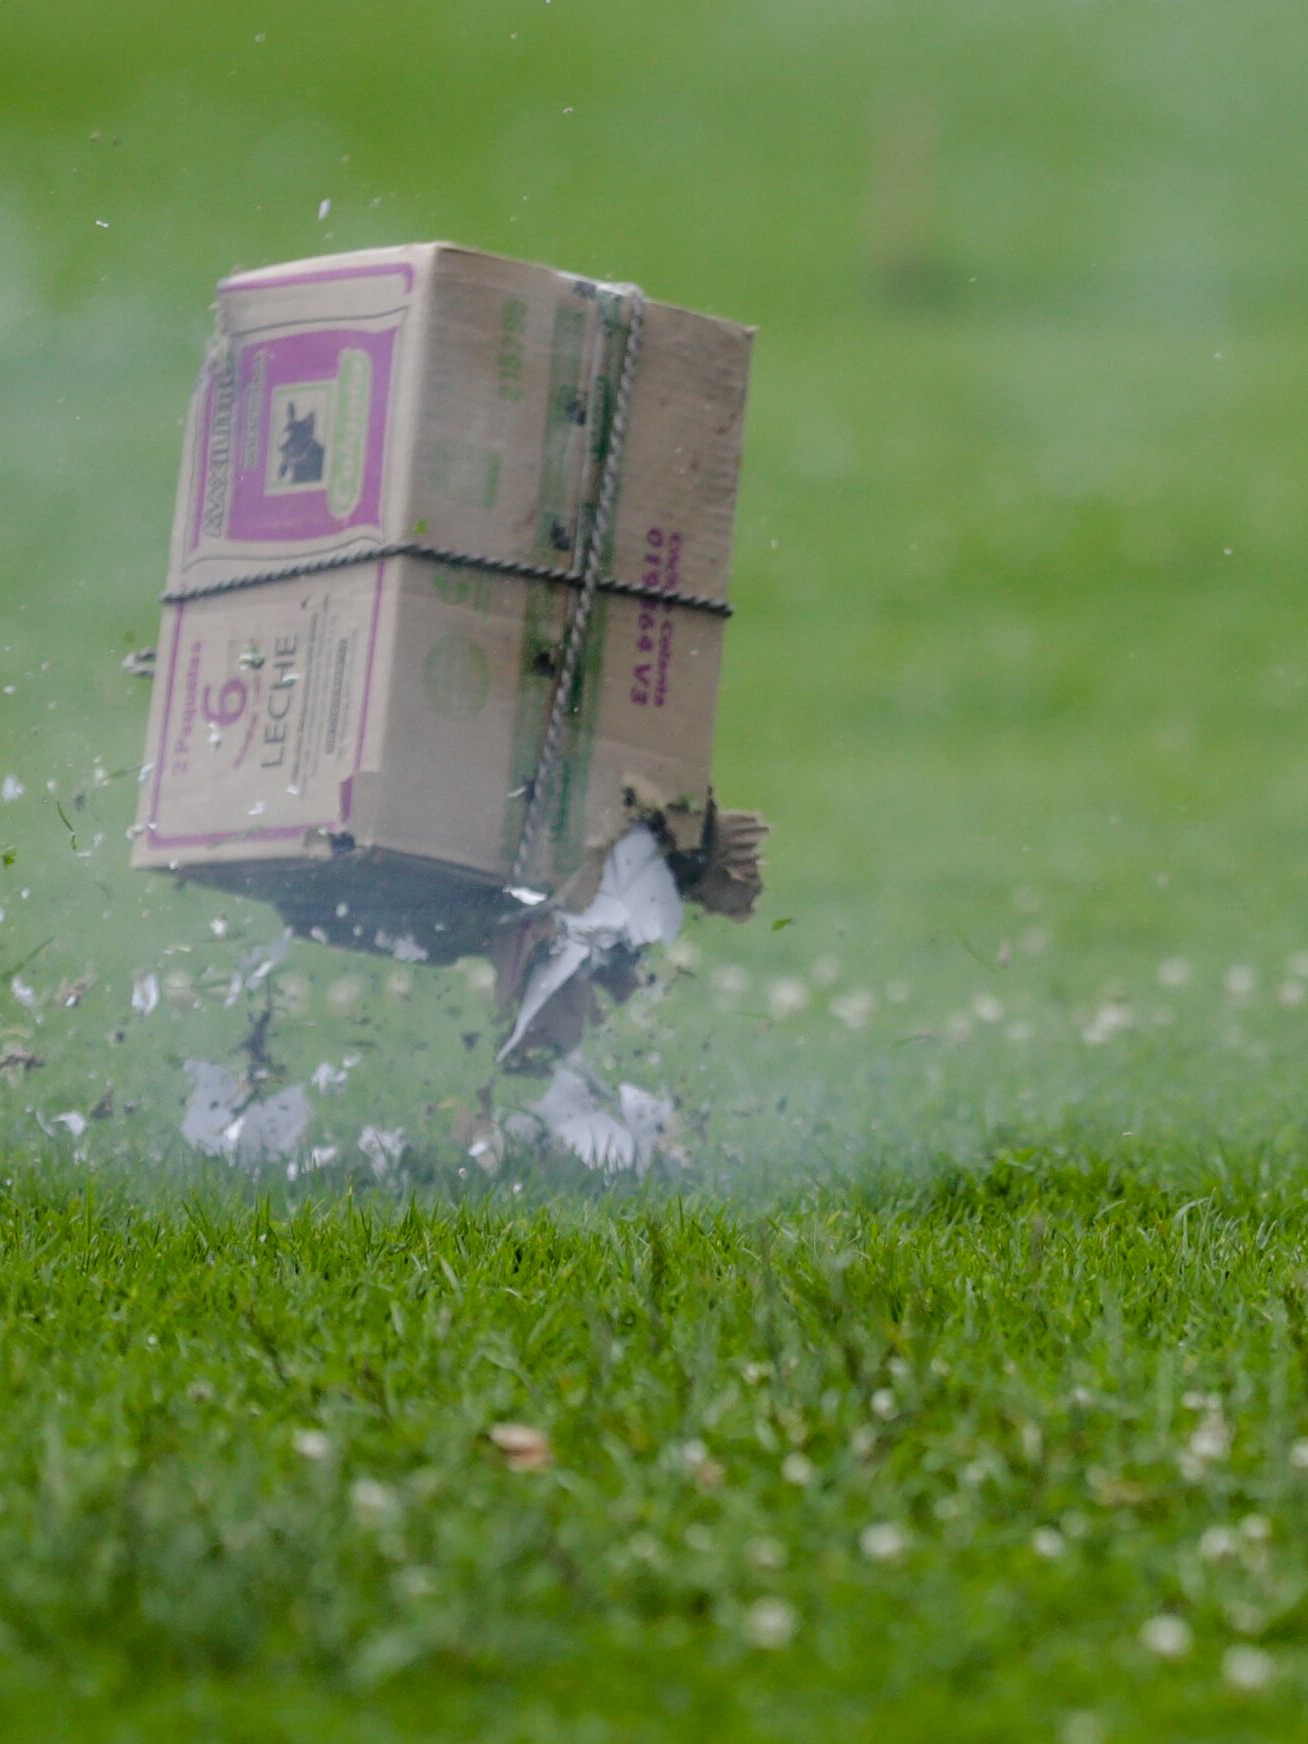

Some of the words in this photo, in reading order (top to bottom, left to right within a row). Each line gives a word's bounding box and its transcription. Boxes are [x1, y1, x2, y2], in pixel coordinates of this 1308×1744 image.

[175, 641, 202, 754] Paquetes
[202, 678, 248, 726] 6
[261, 634, 298, 769] LECHE
